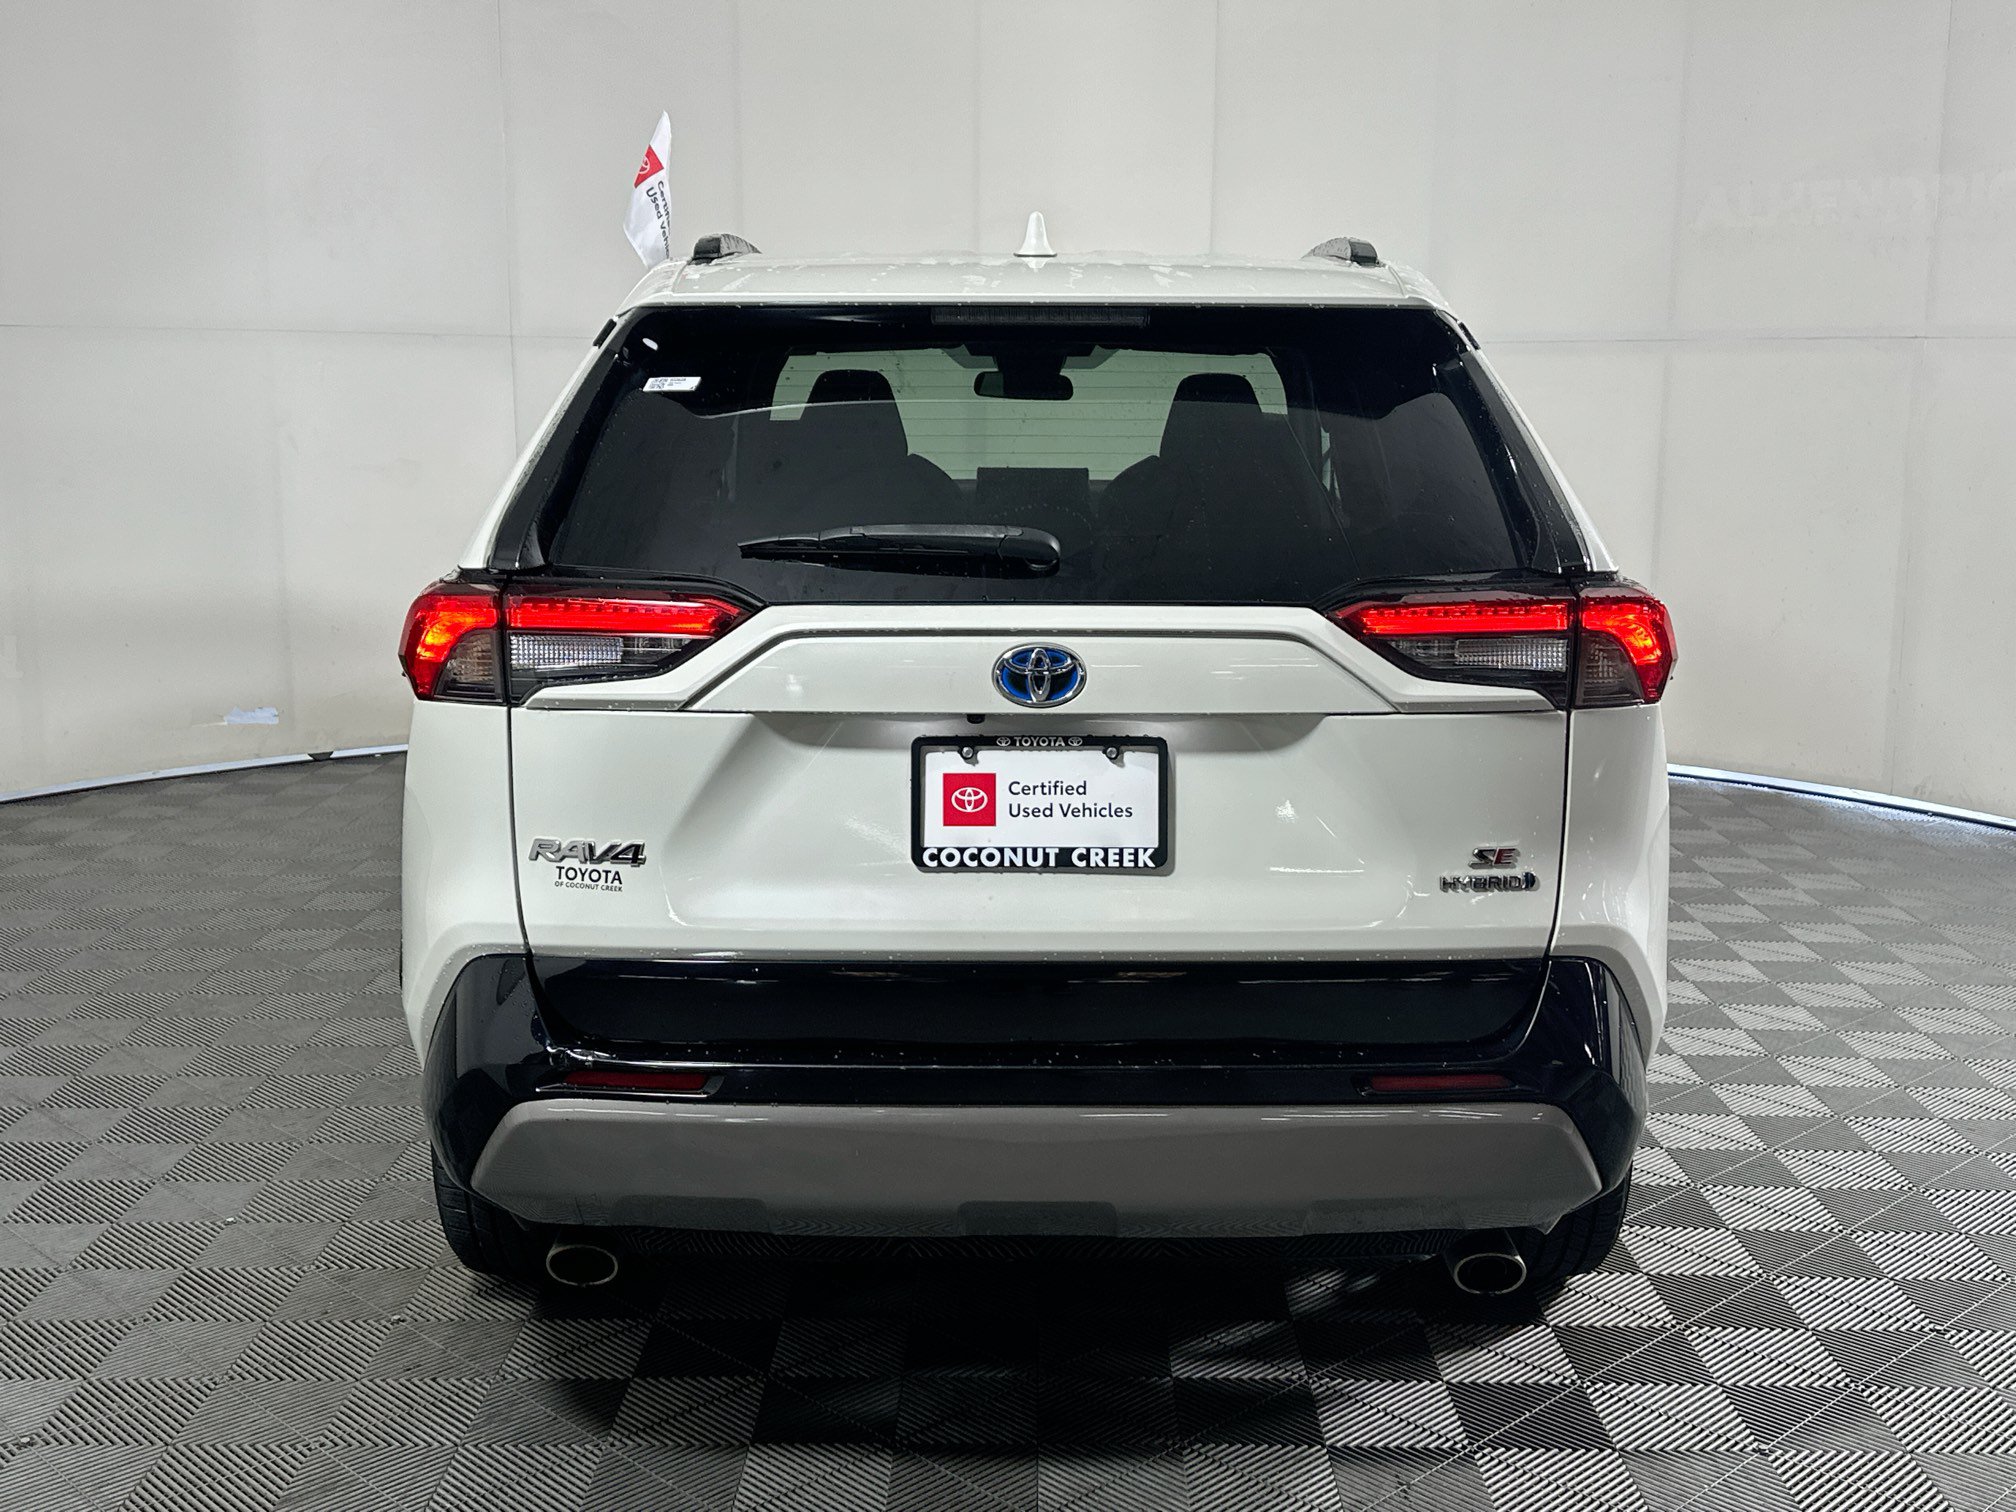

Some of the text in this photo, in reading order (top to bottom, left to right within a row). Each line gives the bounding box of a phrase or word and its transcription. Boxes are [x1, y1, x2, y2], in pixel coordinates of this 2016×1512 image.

[647, 186, 663, 220] Used
[1014, 737, 1065, 747] TOYOTA
[1008, 781, 1087, 796] Certified
[1008, 803, 1133, 818] Used Vehicles
[528, 838, 647, 867] RAV4
[922, 847, 1156, 867] COCONUT CREEK
[1468, 847, 1520, 869] SE
[555, 866, 623, 885] TOYOTA
[1440, 875, 1522, 893] HYBRID
[565, 881, 600, 891] COCONUT
